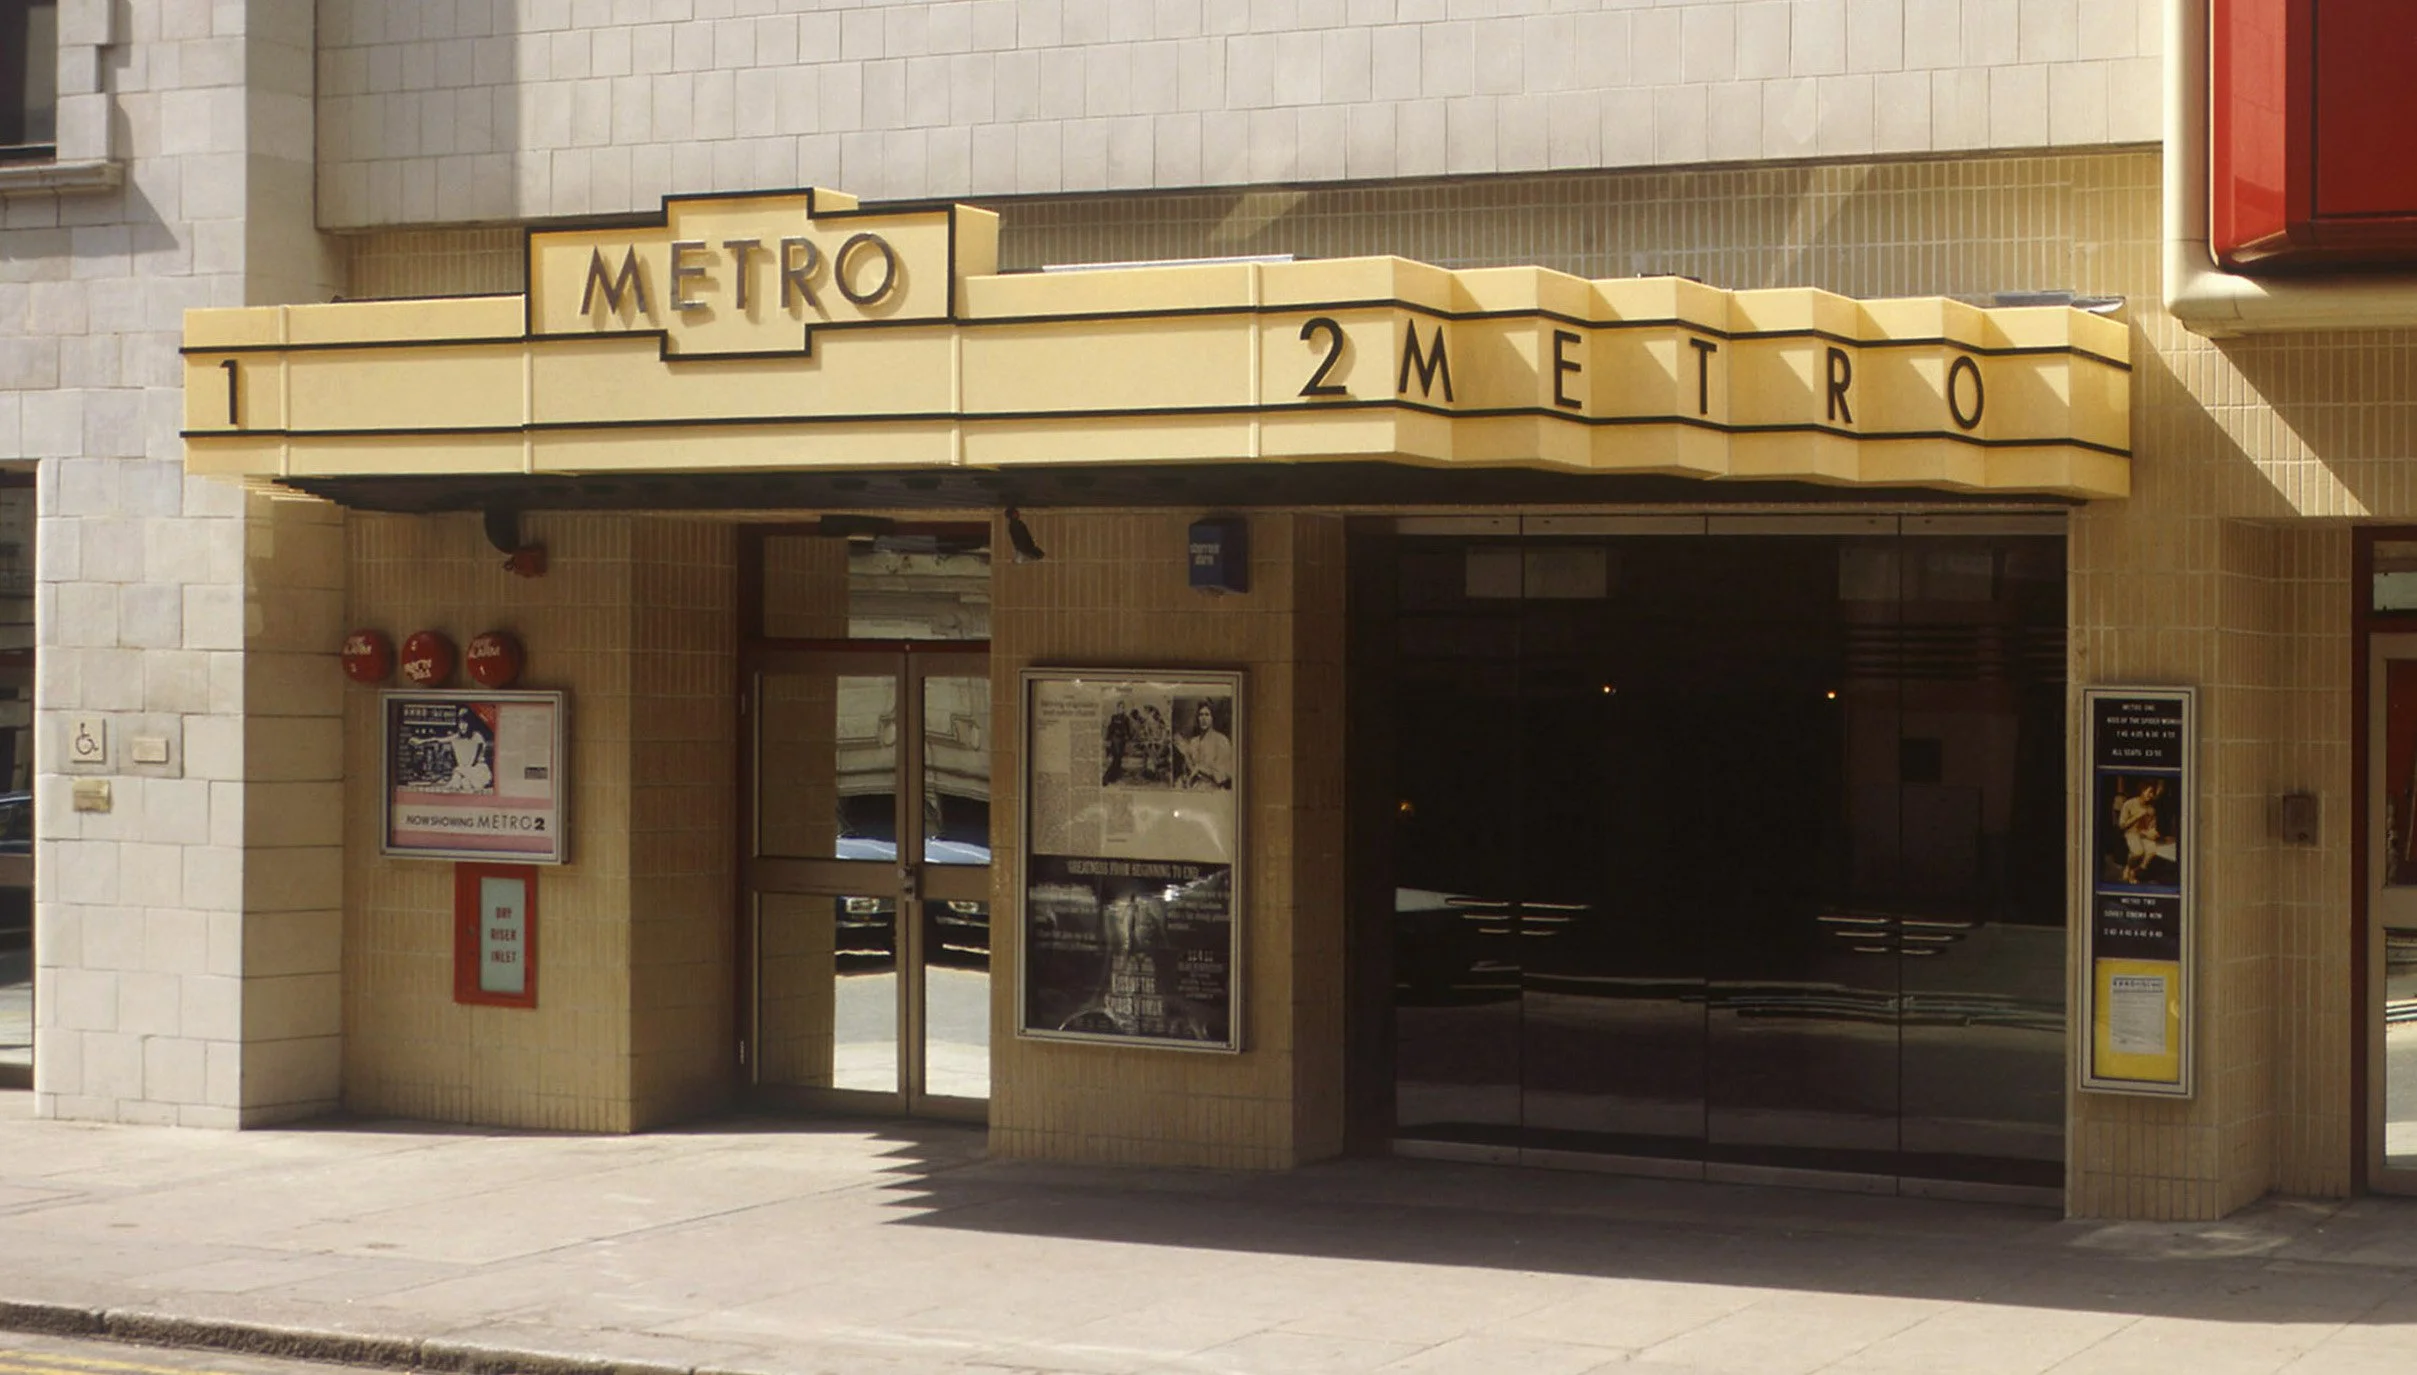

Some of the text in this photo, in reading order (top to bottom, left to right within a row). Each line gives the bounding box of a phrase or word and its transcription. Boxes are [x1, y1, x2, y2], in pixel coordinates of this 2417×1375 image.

[580, 232, 897, 316] METRO
[1298, 317, 1347, 397] 2
[1399, 317, 1985, 431] METRO
[221, 359, 240, 425] 1
[405, 814, 546, 831] NOW SHOWING METRO 2
[496, 907, 512, 919] DRY
[491, 928, 517, 941] RISER
[491, 950, 517, 963] INLET
